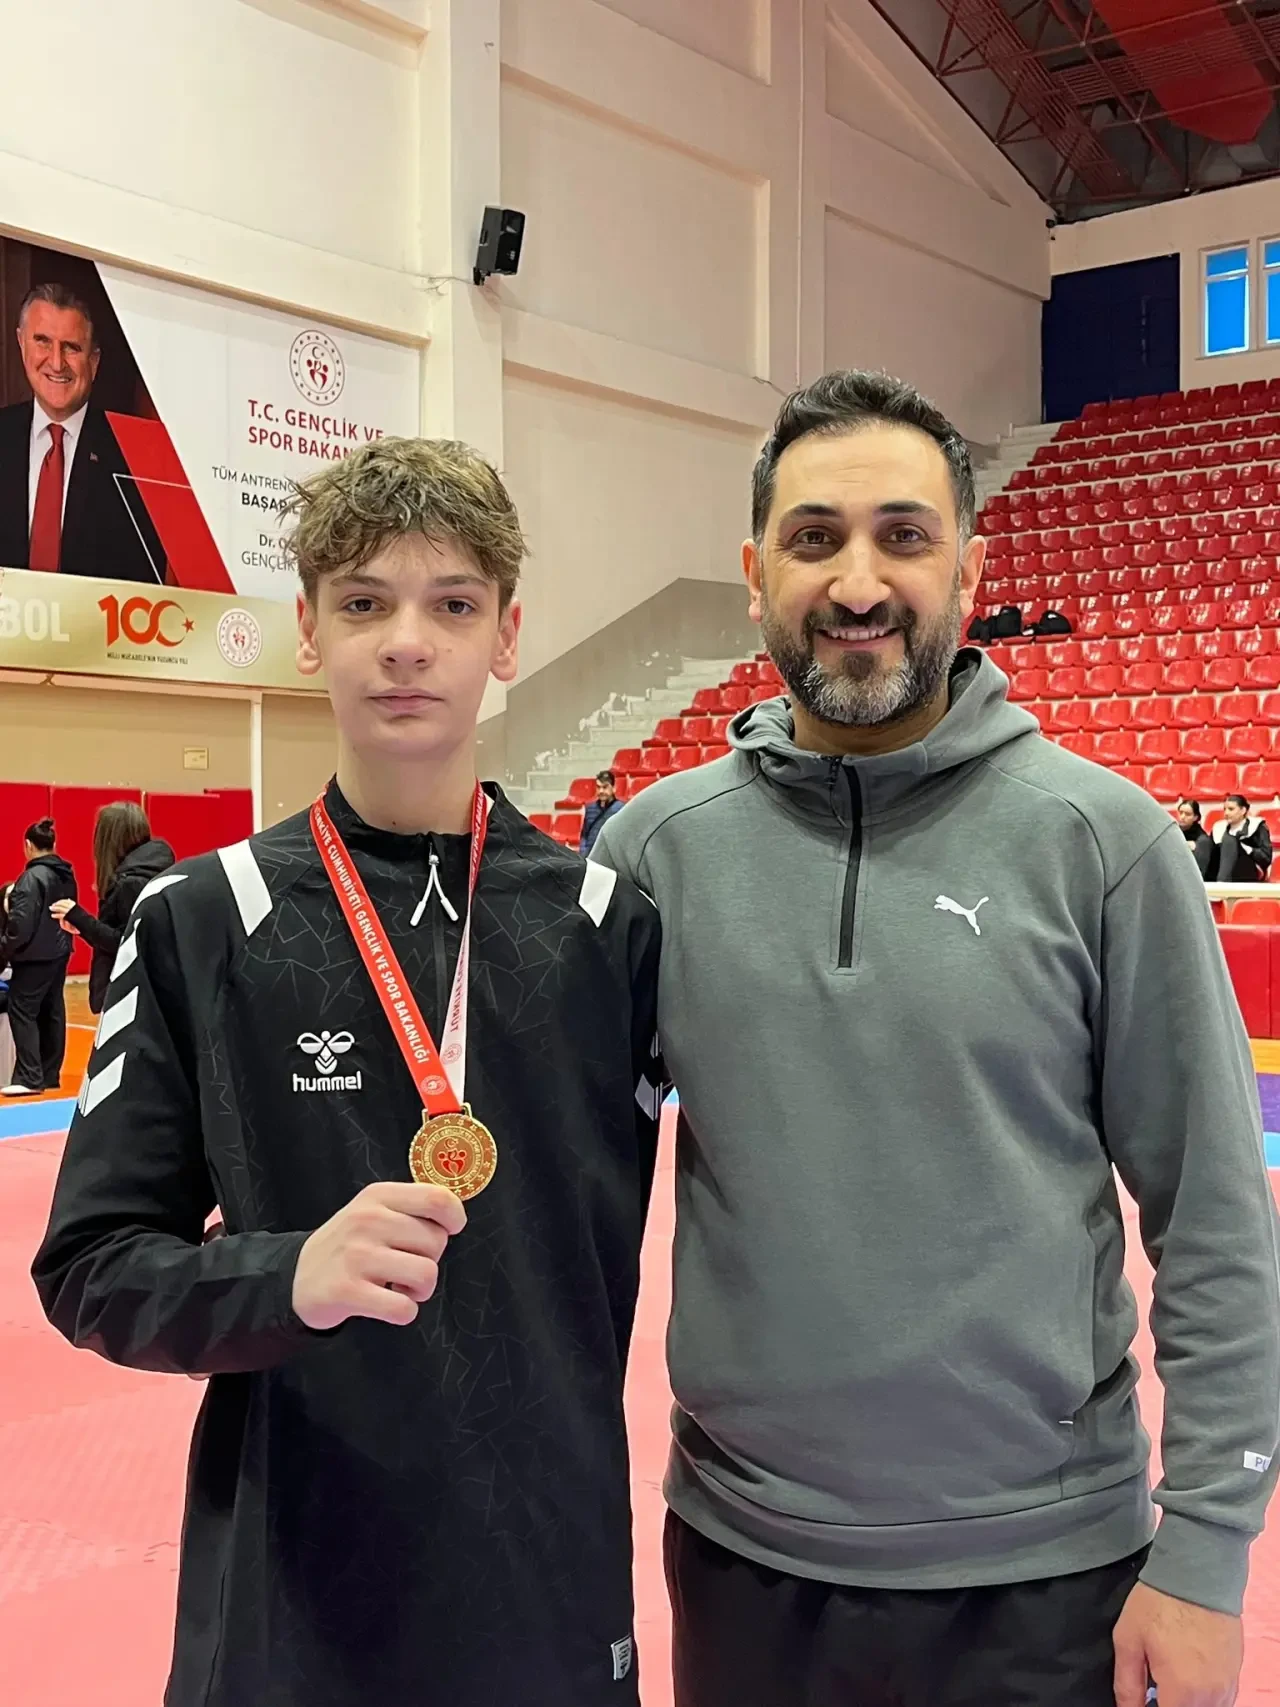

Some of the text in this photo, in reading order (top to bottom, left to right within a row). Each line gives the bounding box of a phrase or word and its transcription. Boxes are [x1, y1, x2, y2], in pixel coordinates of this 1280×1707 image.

[248, 399, 279, 423] T.C.
[285, 408, 358, 441] GENÇLİK
[248, 426, 293, 451] SPOR
[212, 465, 238, 482] TÜM
[259, 533, 276, 549] Dr.
[327, 844, 362, 910] CUMHURİYETİ
[355, 909, 384, 957] GENÇLİK
[375, 953, 389, 971] VE
[380, 967, 403, 1001] SPOR
[392, 1000, 430, 1064] BAKANLIĞI
[292, 1071, 362, 1092] hummel
